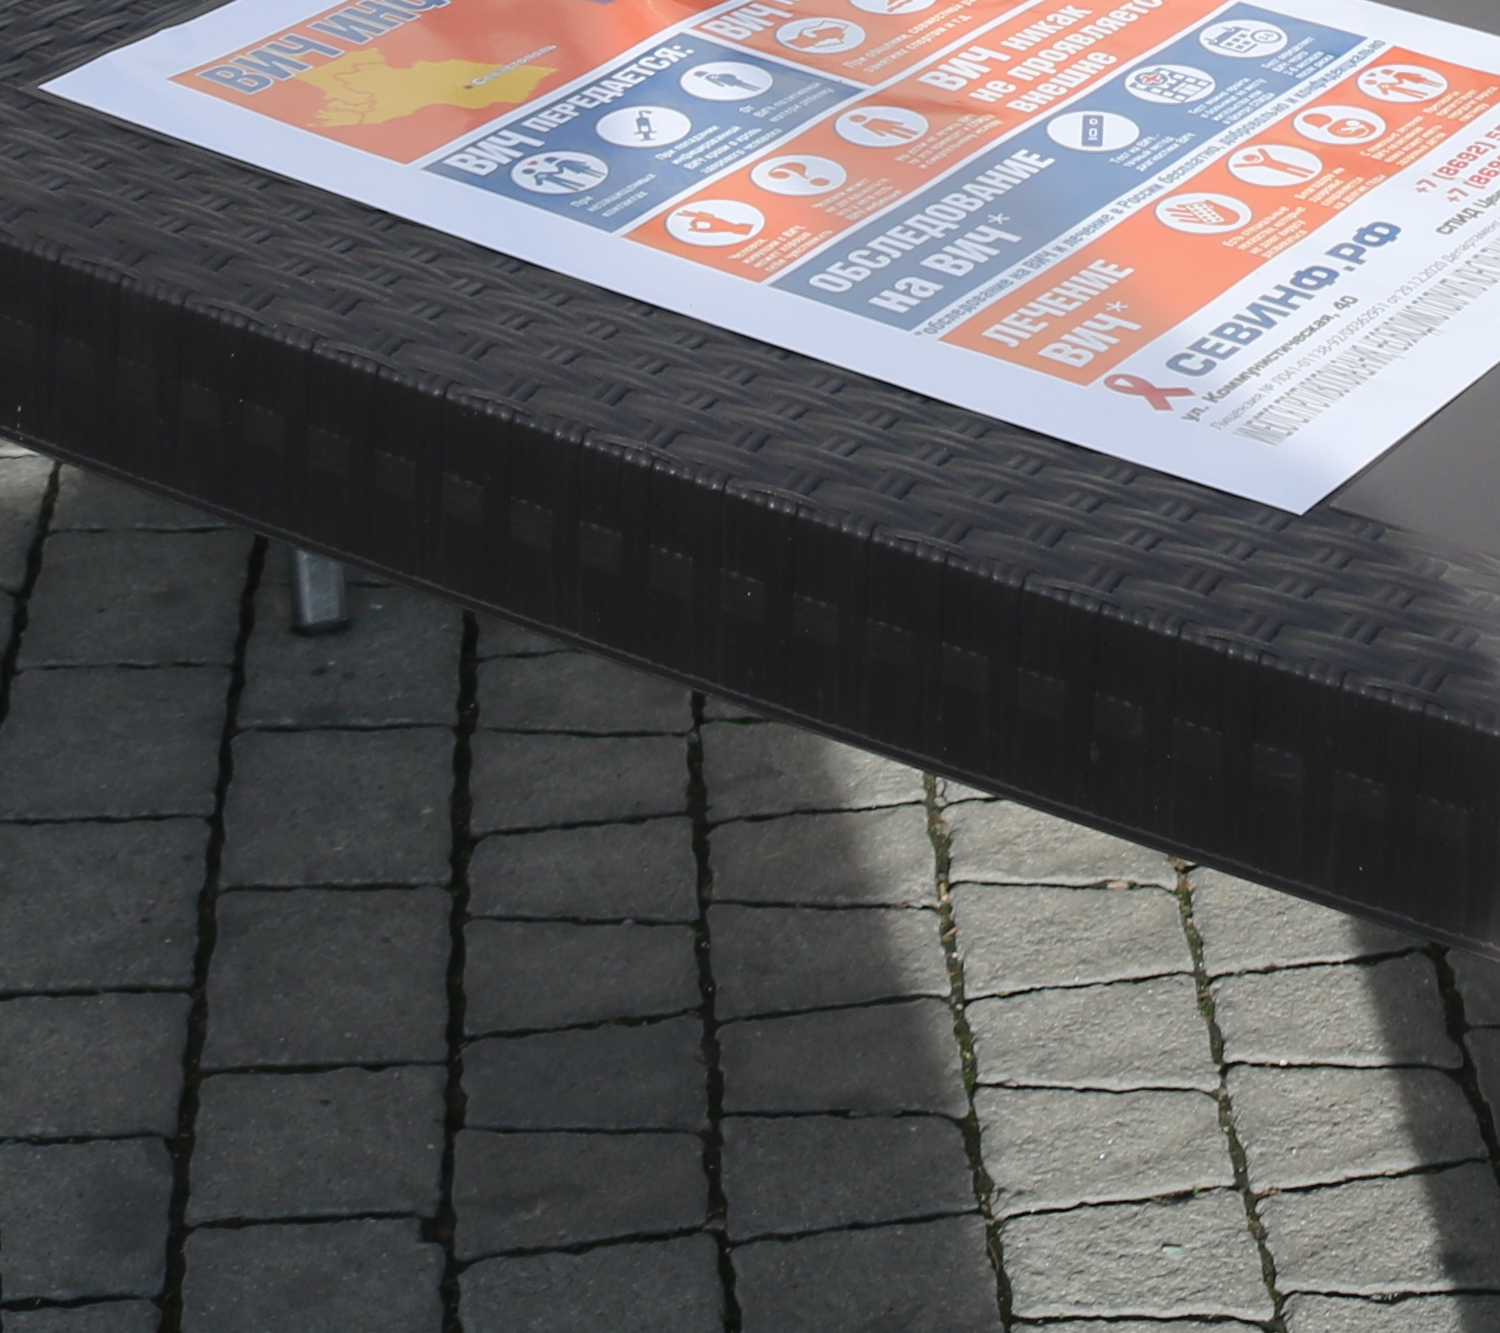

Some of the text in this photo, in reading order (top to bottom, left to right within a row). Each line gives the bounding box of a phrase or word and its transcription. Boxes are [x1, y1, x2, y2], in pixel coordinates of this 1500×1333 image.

[702, 3, 791, 39] ВИЧ
[916, 6, 1091, 89] ВИЧ никак
[197, 34, 344, 93] ВИЧ
[967, 79, 1019, 102] не
[1006, 53, 1119, 111] внешне
[443, 46, 698, 175] ВИЧ ПЕРЕДАЕТСЯ:
[1007, 267, 1031, 279] на
[1022, 250, 1057, 268] ВИЧ
[1060, 214, 1115, 245] лечение
[1116, 182, 1165, 208] России
[1218, 103, 1290, 144] добровольно
[1407, 178, 1441, 194] +7
[1429, 141, 1496, 179] (8692)
[1438, 187, 1472, 203] +7
[810, 154, 1057, 290] ОБСЛЕДОВАНИЕ
[1435, 207, 1484, 235] СПИД
[867, 275, 944, 312] на
[982, 261, 1131, 345] ЛЕЧЕНИЕ
[1168, 224, 1401, 373] СЕВИНФ.РФ
[1178, 294, 1361, 422] ул. Коммунистическая, 40
